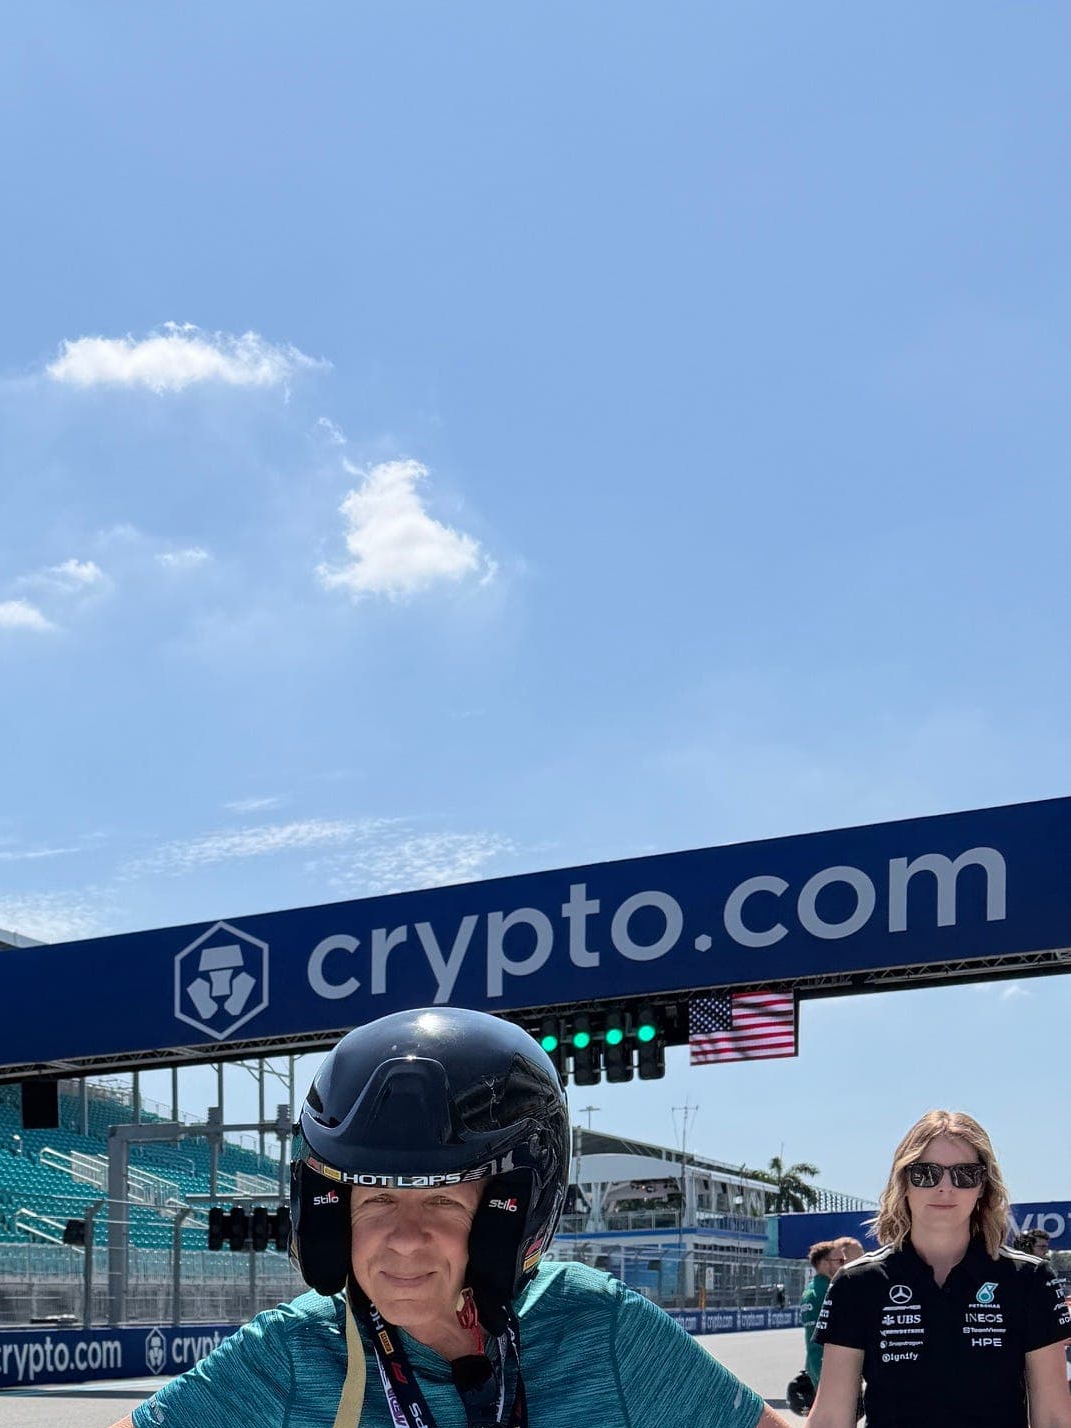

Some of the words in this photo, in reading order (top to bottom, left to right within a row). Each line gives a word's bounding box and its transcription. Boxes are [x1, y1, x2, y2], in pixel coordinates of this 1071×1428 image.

[307, 846, 1007, 1004] crypto.com
[343, 1172, 393, 1186] HOT
[896, 1314, 921, 1325] UBS
[965, 1313, 1004, 1323] INEOS
[971, 1338, 1003, 1347] HPE
